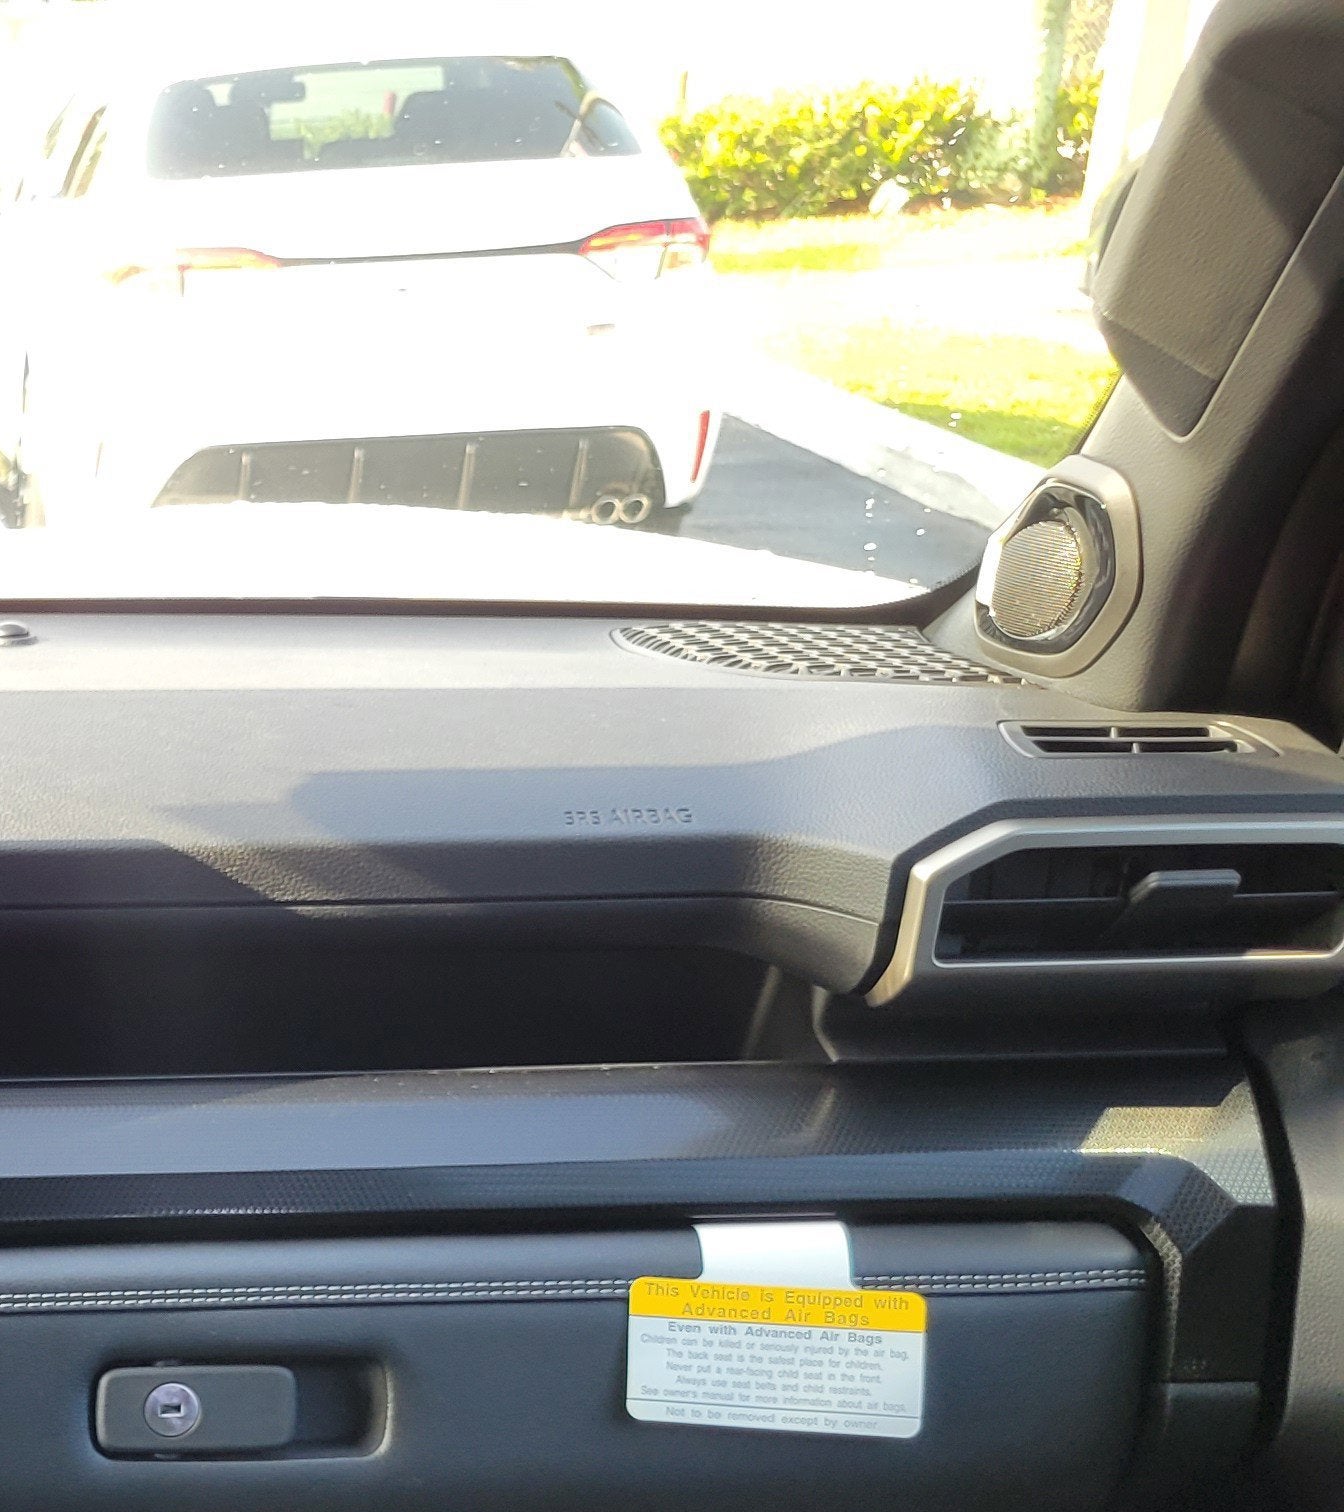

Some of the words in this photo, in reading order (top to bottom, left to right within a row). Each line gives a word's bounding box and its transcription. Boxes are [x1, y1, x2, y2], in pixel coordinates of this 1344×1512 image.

[563, 810, 601, 826] SRS
[610, 807, 693, 825] AIRBAG
[645, 1282, 679, 1297] This
[690, 1284, 751, 1301] Vehicle
[760, 1289, 775, 1303] is
[785, 1290, 863, 1309] Equipped
[874, 1295, 910, 1310] with
[682, 1302, 772, 1320] Advanced
[785, 1308, 810, 1322] Air
[824, 1310, 870, 1327] Bags
[667, 1321, 701, 1334] Even
[708, 1323, 737, 1336] with
[744, 1325, 812, 1341] Advanced
[819, 1330, 841, 1342] Air
[847, 1332, 883, 1346] Bags
[666, 1406, 685, 1417] Not
[691, 1408, 702, 1418] to
[707, 1409, 722, 1420] be
[727, 1411, 775, 1423] removed
[781, 1414, 818, 1427] except
[824, 1416, 838, 1429] by
